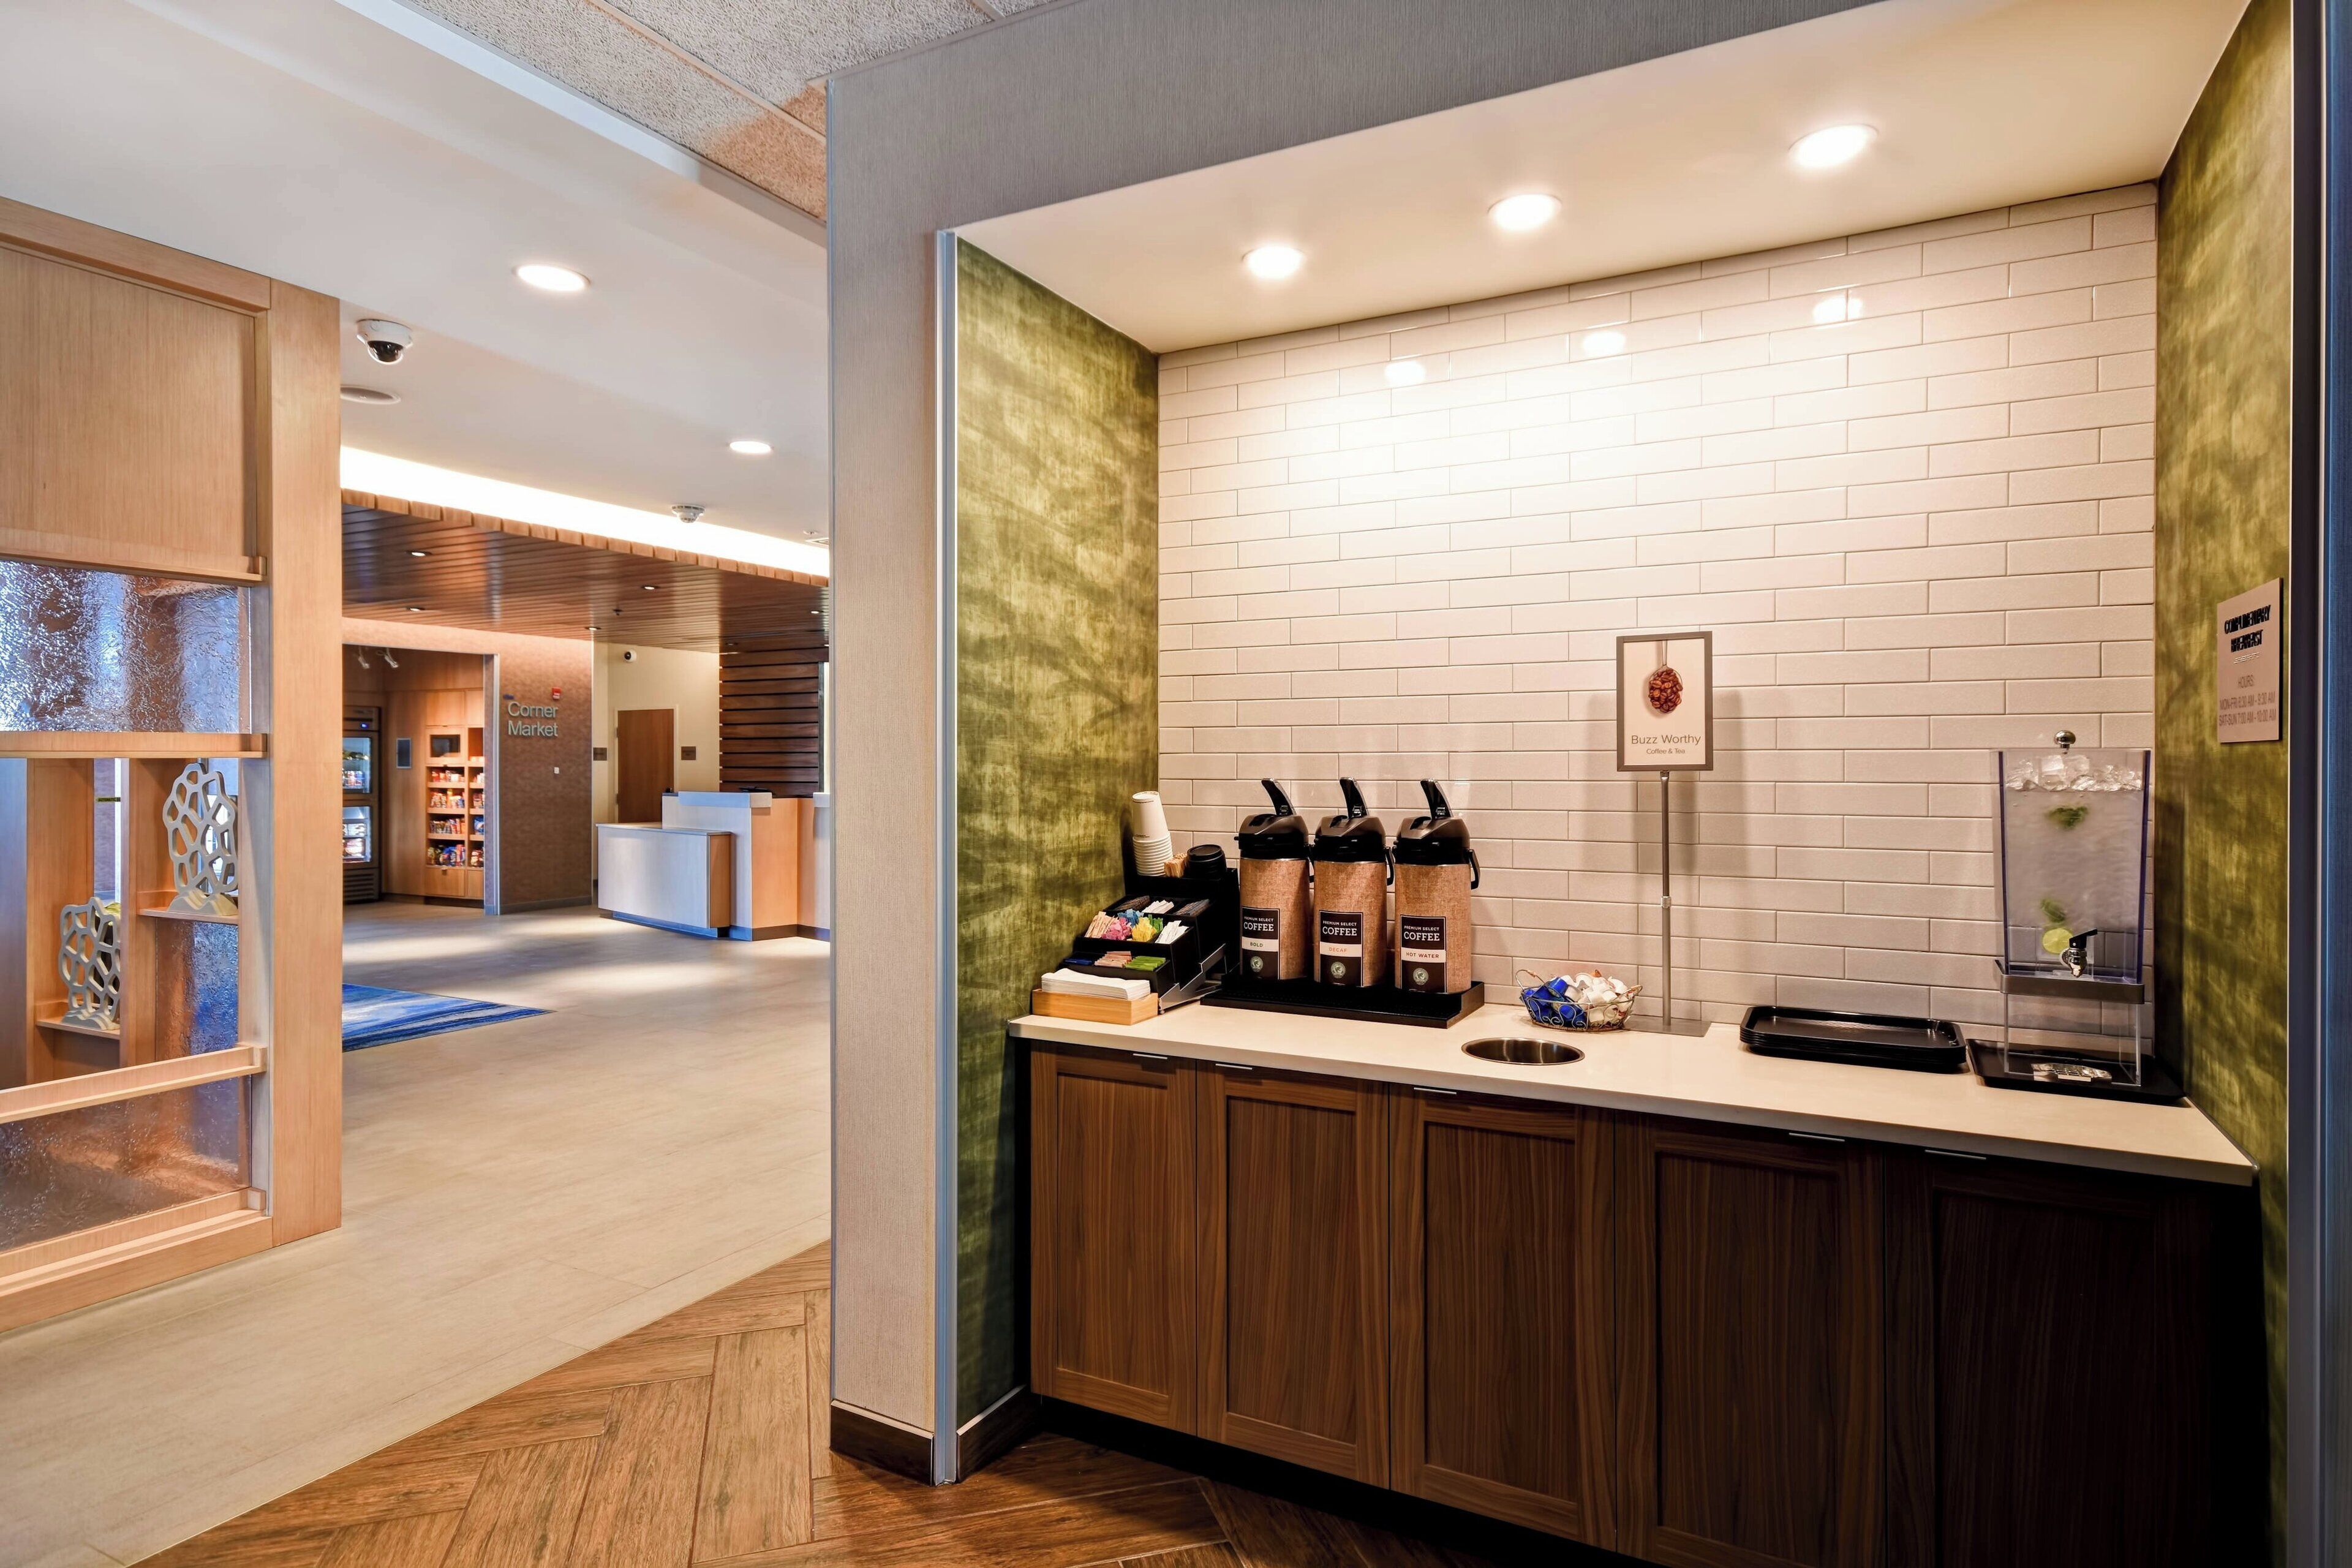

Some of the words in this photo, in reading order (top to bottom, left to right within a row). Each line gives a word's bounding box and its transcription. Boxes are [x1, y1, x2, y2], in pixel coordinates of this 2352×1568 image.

[508, 701, 559, 718] Corner
[508, 720, 559, 737] Market
[1631, 735, 1657, 744] Buzz
[1661, 734, 1702, 745] Worthy
[1243, 922, 1274, 931] COFFEE
[1322, 926, 1357, 936] COFFEE
[1403, 931, 1440, 941] COFFEE
